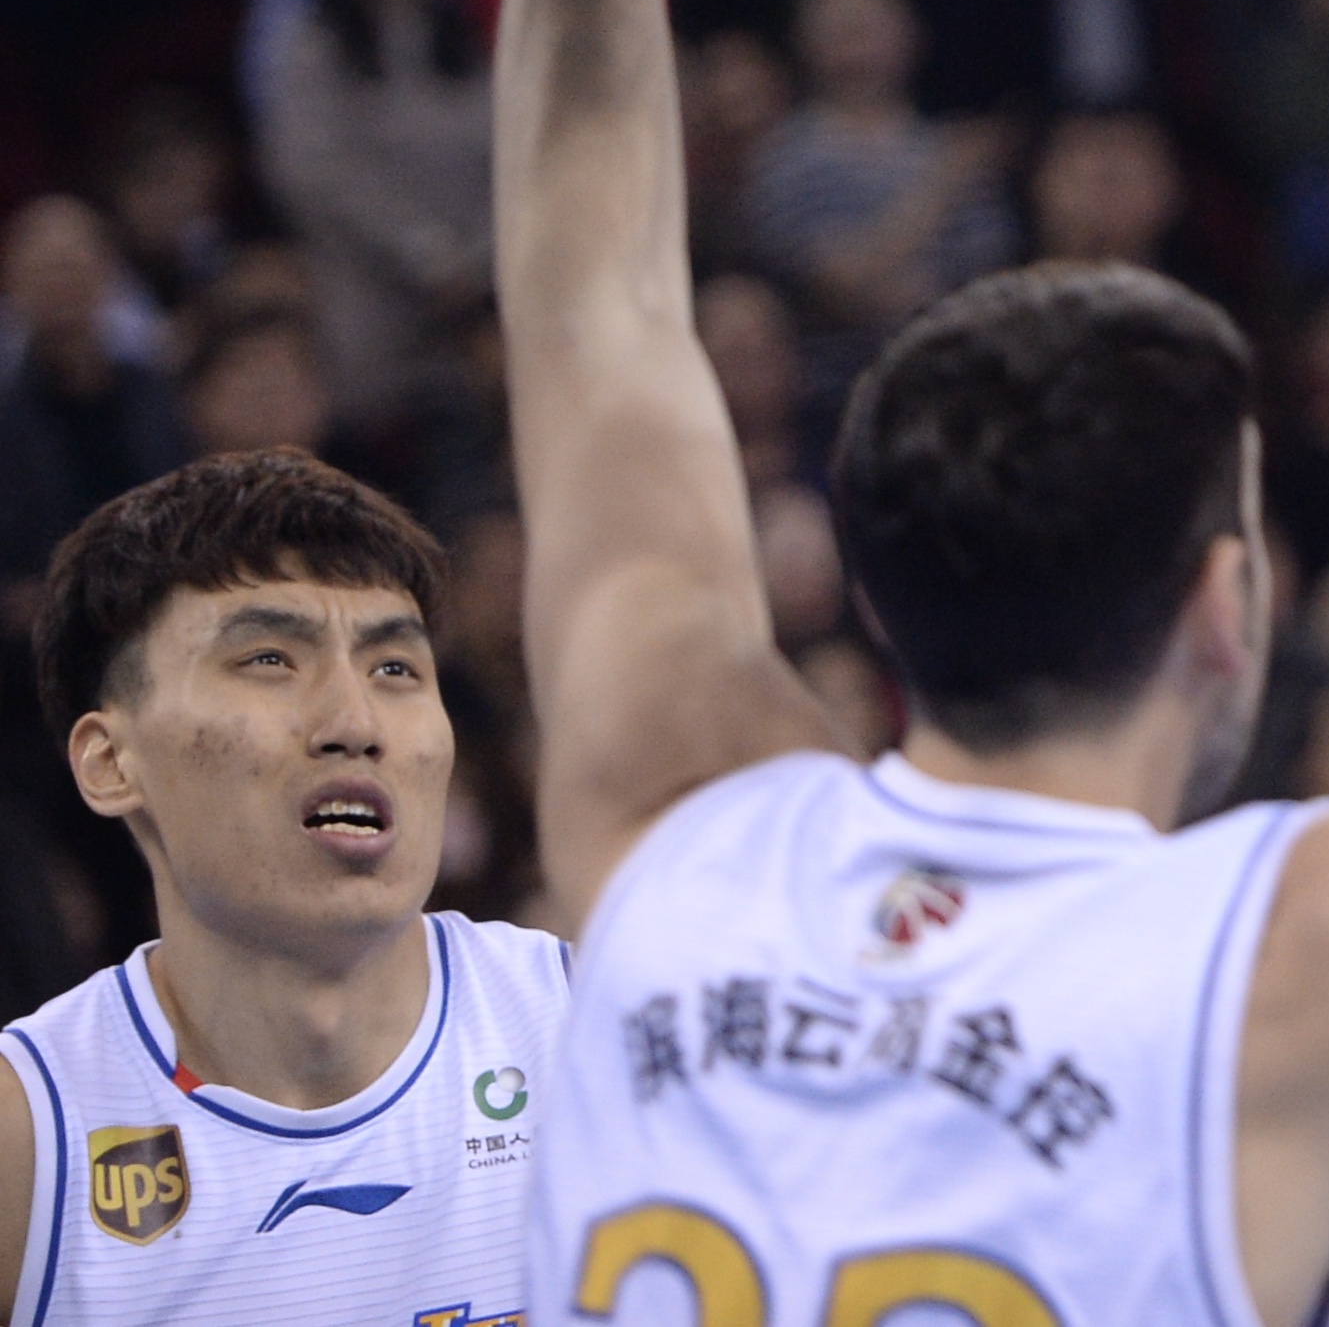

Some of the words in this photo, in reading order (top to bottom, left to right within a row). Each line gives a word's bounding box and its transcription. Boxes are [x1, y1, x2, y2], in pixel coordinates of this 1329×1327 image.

[465, 1133, 531, 1155] 中国人
[468, 1154, 517, 1170] CHINA
[95, 1156, 184, 1228] ups
